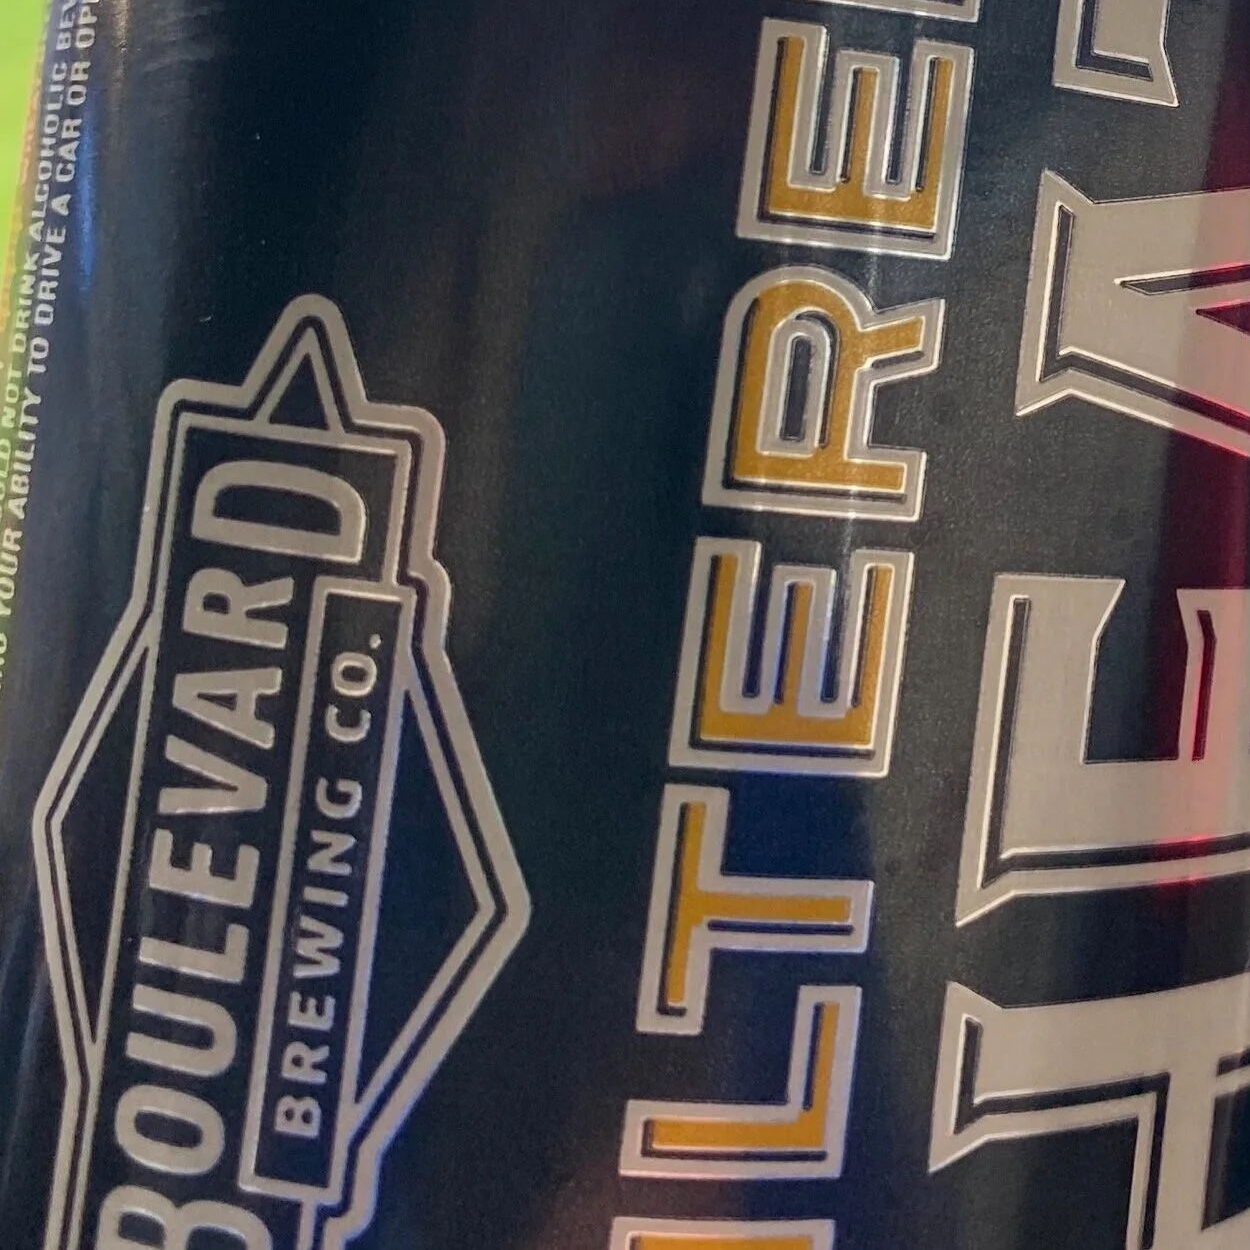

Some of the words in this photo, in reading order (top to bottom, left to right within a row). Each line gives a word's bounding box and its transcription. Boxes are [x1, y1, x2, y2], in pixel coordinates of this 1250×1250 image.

[66, 60, 92, 106] OR
[29, 61, 67, 242] ALCOHOLIC
[55, 118, 82, 183] CAR
[51, 192, 71, 217] A
[12, 251, 40, 351] DRINK
[33, 225, 67, 326] DRIVE
[1, 366, 25, 428] NOT
[27, 335, 50, 376] TO
[8, 387, 42, 520] ABILITY
[0, 528, 23, 616] YOUR
[97, 459, 367, 1250] BOULEVARD
[274, 777, 363, 1140] BREWING
[324, 633, 382, 744] CO.
